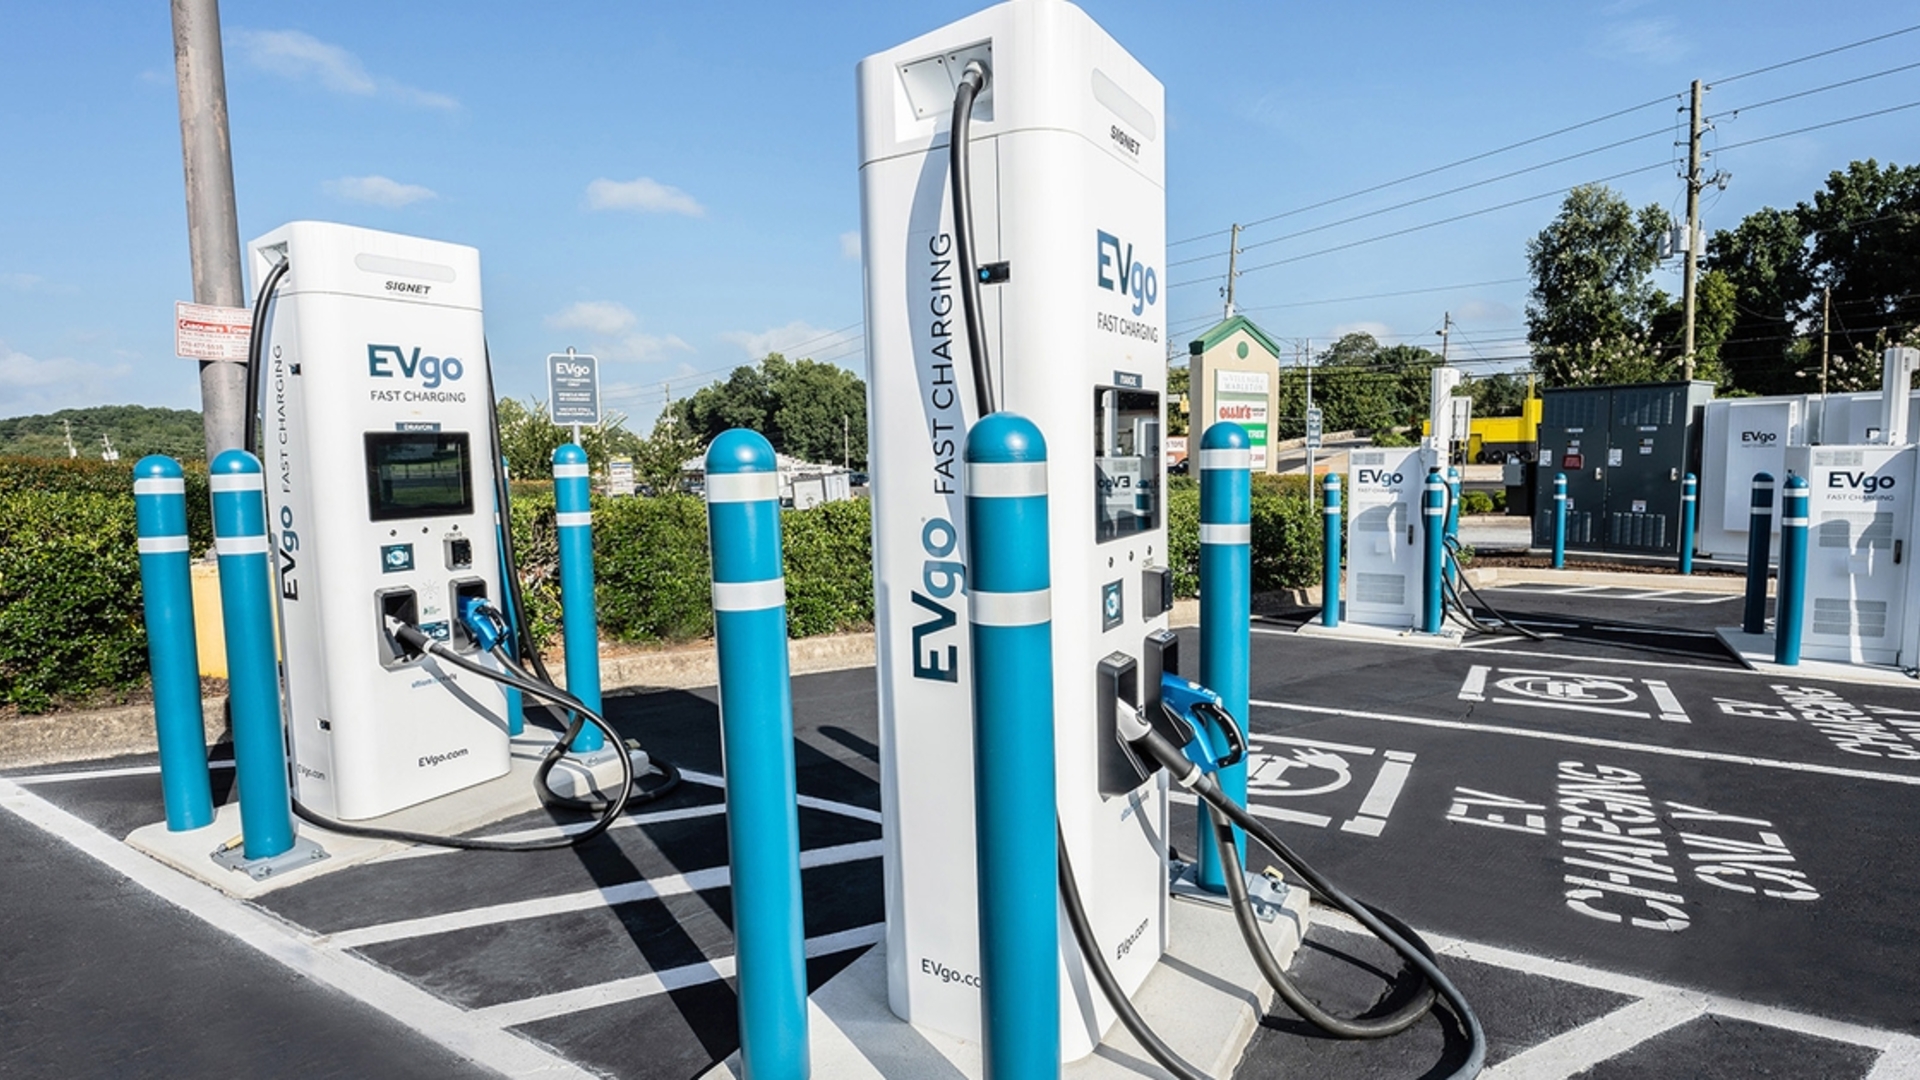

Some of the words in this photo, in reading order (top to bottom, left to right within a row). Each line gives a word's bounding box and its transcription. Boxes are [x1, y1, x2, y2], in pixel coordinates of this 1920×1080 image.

[1110, 125, 1141, 156] SIGNET
[385, 281, 431, 295] SIGNET
[1097, 229, 1157, 316] EVgo
[929, 232, 954, 410] CHARGING
[1097, 312, 1119, 333] FAST
[1120, 318, 1158, 343] CHARGING
[367, 344, 464, 388] EVgo
[556, 363, 590, 377] EVgo
[273, 345, 288, 445] CHARGING
[370, 390, 401, 402] FAST
[403, 391, 466, 403] CHARGING
[932, 418, 955, 494] FAST
[1742, 431, 1776, 444] EVgo
[280, 449, 291, 493] FAST
[1358, 469, 1403, 487] EVgo
[1829, 471, 1895, 493] EVgo
[1848, 494, 1895, 502] CHARGING
[280, 505, 299, 601] EVgo
[911, 517, 967, 683] EVgo
[418, 747, 469, 768] EVgo.com
[1446, 786, 1546, 835] EV
[1557, 761, 1690, 932] CHARGING
[1665, 801, 1821, 900] ONLY
[1116, 918, 1149, 960] EVgo.com
[922, 958, 981, 988] EVgo.co
